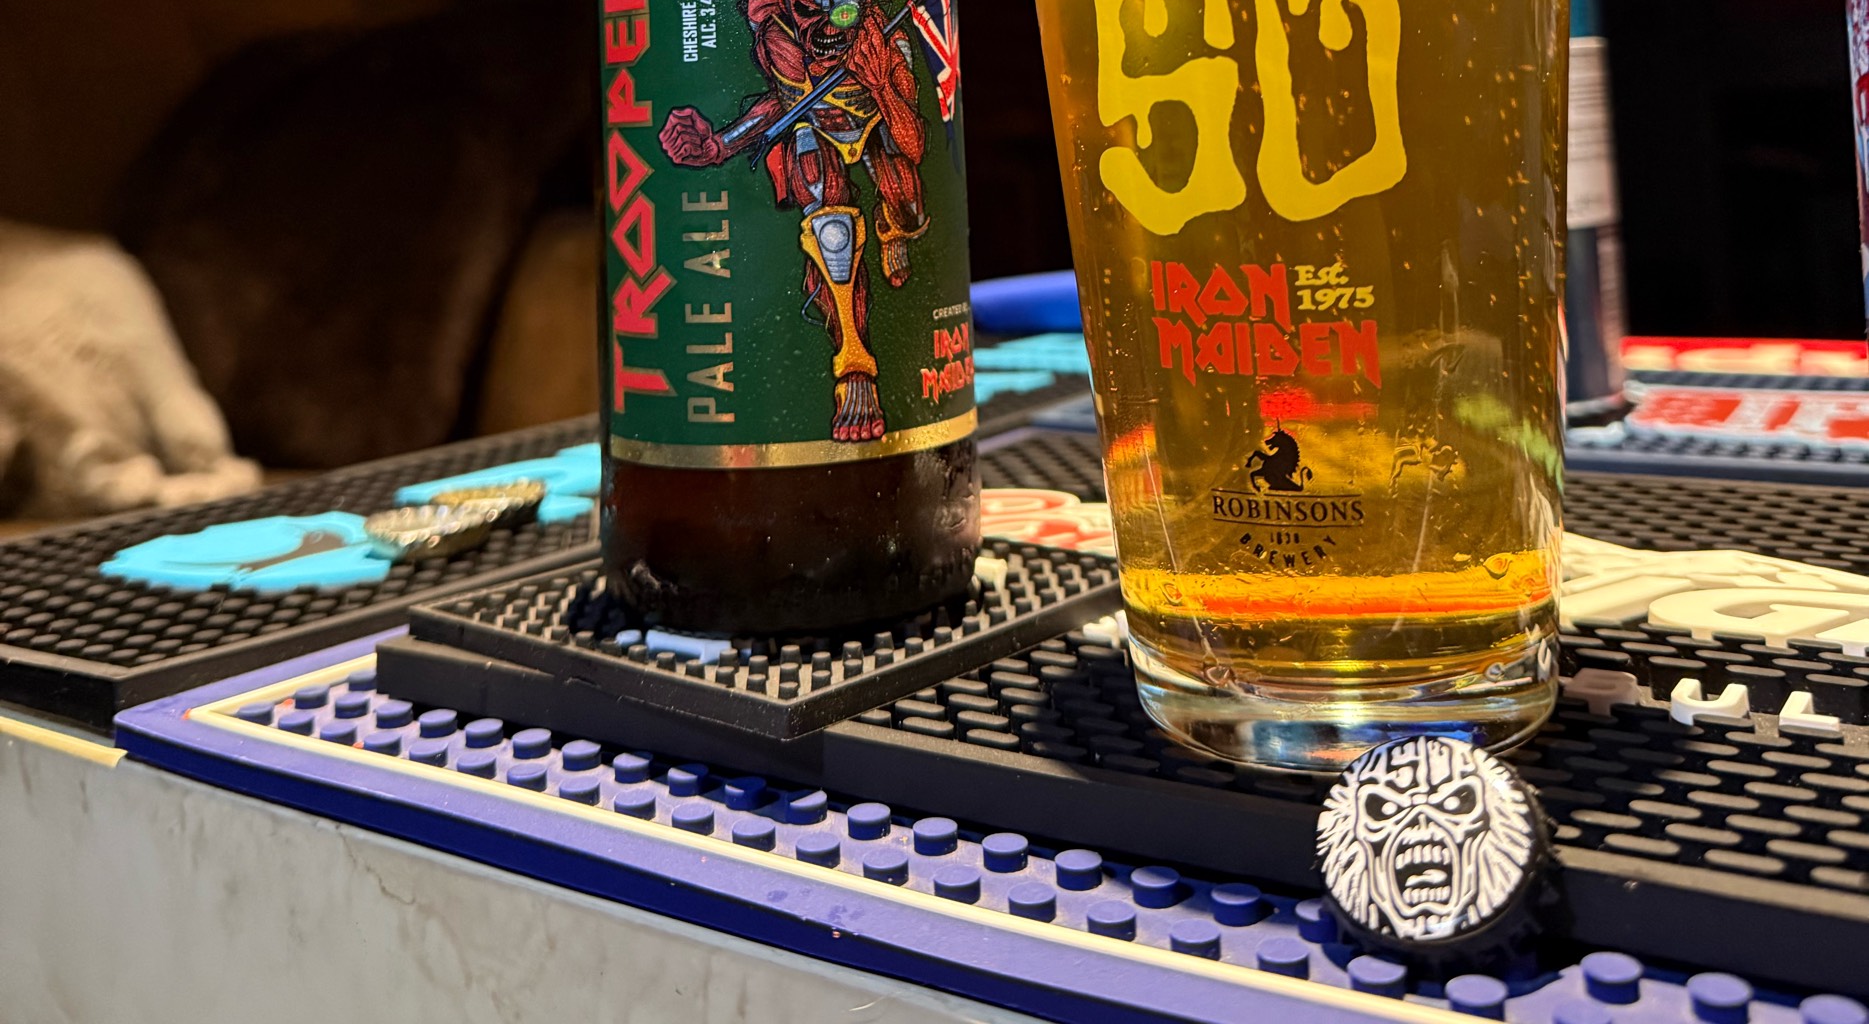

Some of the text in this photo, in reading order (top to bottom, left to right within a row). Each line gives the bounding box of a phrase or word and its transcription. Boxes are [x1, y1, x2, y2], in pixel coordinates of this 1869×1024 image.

[682, 1, 699, 63] CHESHIRE
[701, 19, 717, 48] ALC.
[682, 189, 736, 424] PALE ALE
[1151, 260, 1350, 334] IRON Est.
[1297, 285, 1376, 311] 1975
[1151, 317, 1383, 390] MAIDEN
[1212, 495, 1365, 523] ROBINSONS
[1239, 532, 1337, 568] BREWERY
